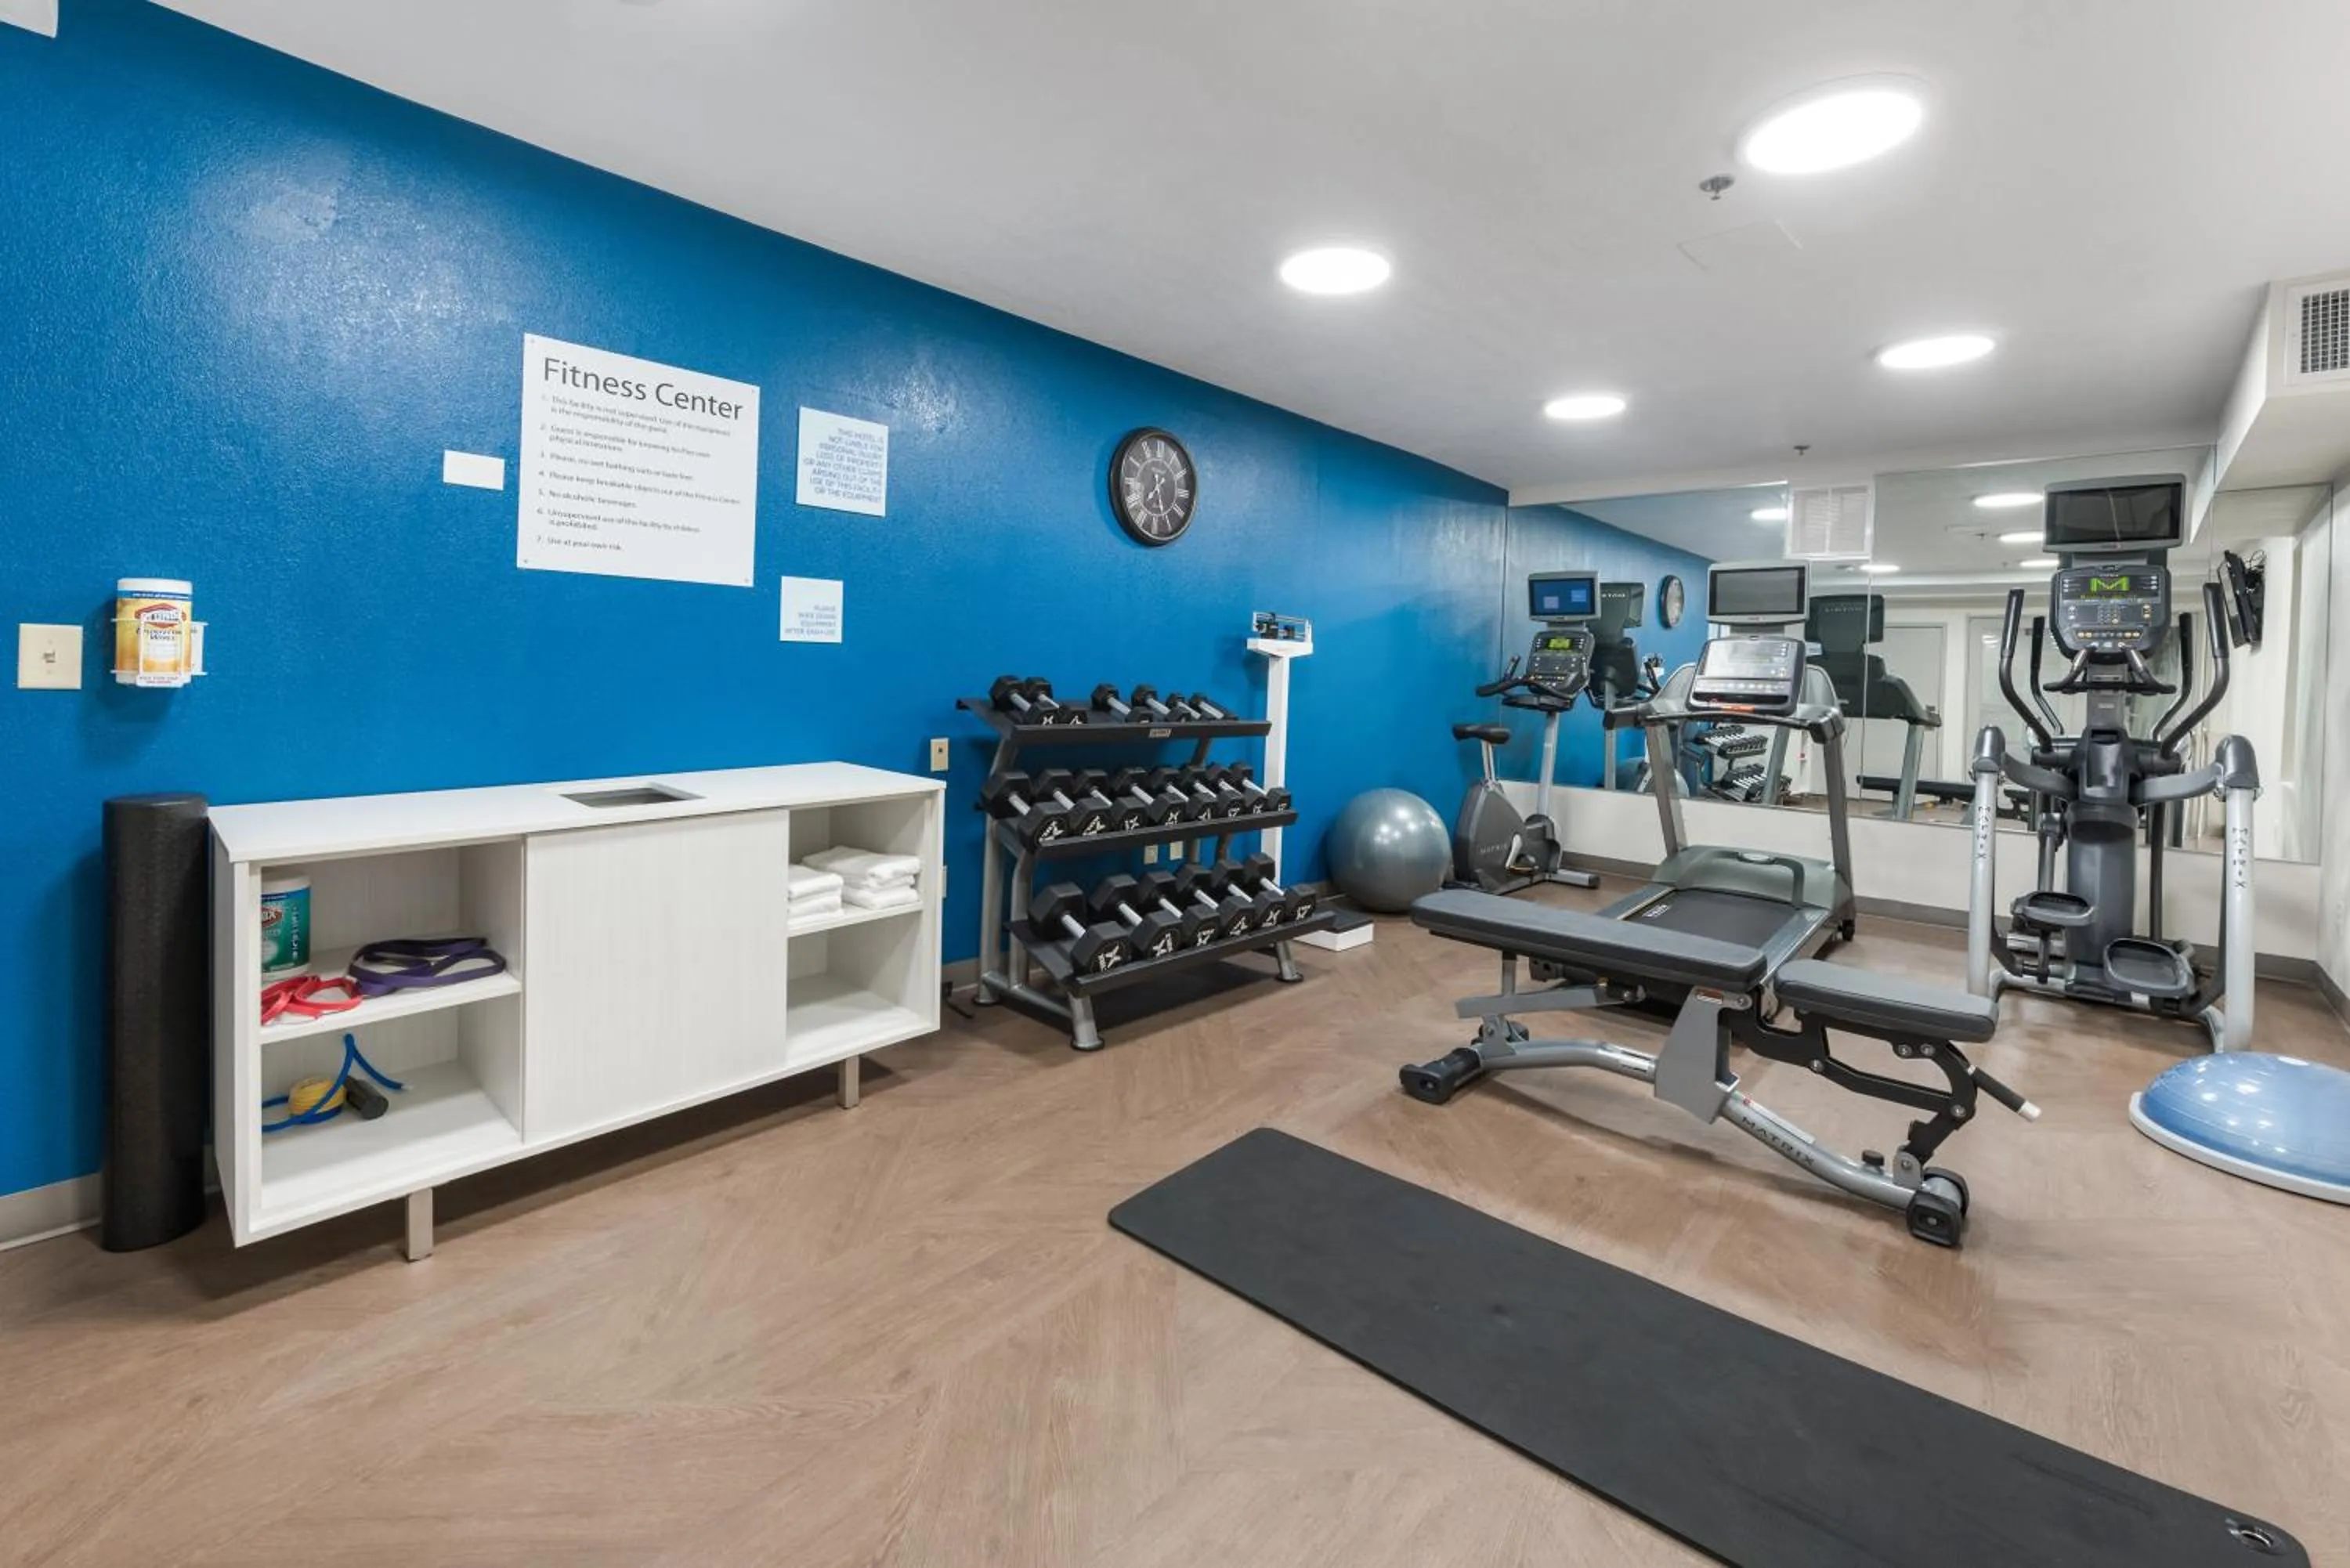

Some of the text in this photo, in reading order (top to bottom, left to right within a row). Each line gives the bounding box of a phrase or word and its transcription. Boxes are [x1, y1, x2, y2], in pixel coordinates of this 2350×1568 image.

[544, 357, 743, 421] Fitness Center
[550, 471, 574, 481] Please
[1976, 806, 1991, 860] MATRIX
[2232, 826, 2249, 890] MATRIX
[1741, 1116, 1816, 1167] MATRIX
